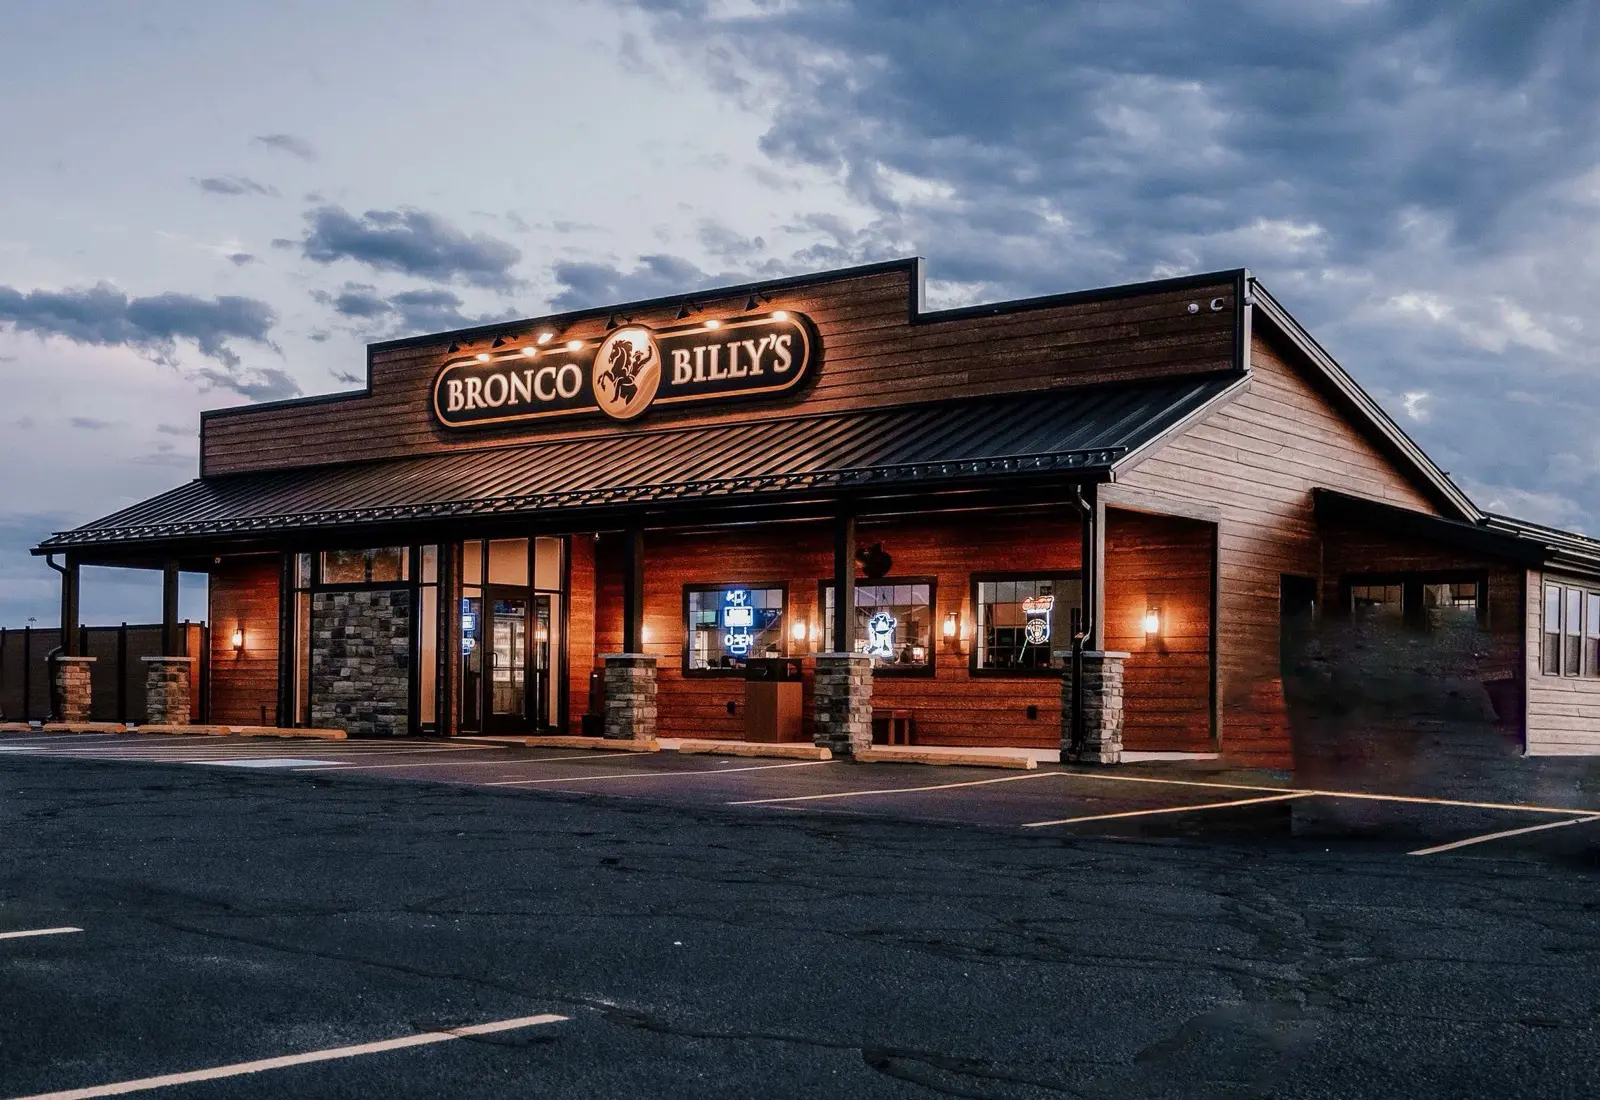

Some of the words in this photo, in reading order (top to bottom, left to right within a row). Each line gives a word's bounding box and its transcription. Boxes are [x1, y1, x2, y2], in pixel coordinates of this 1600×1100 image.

[447, 363, 582, 412] BRONCO
[671, 334, 792, 385] BILLY'S
[724, 634, 753, 645] OPEN
